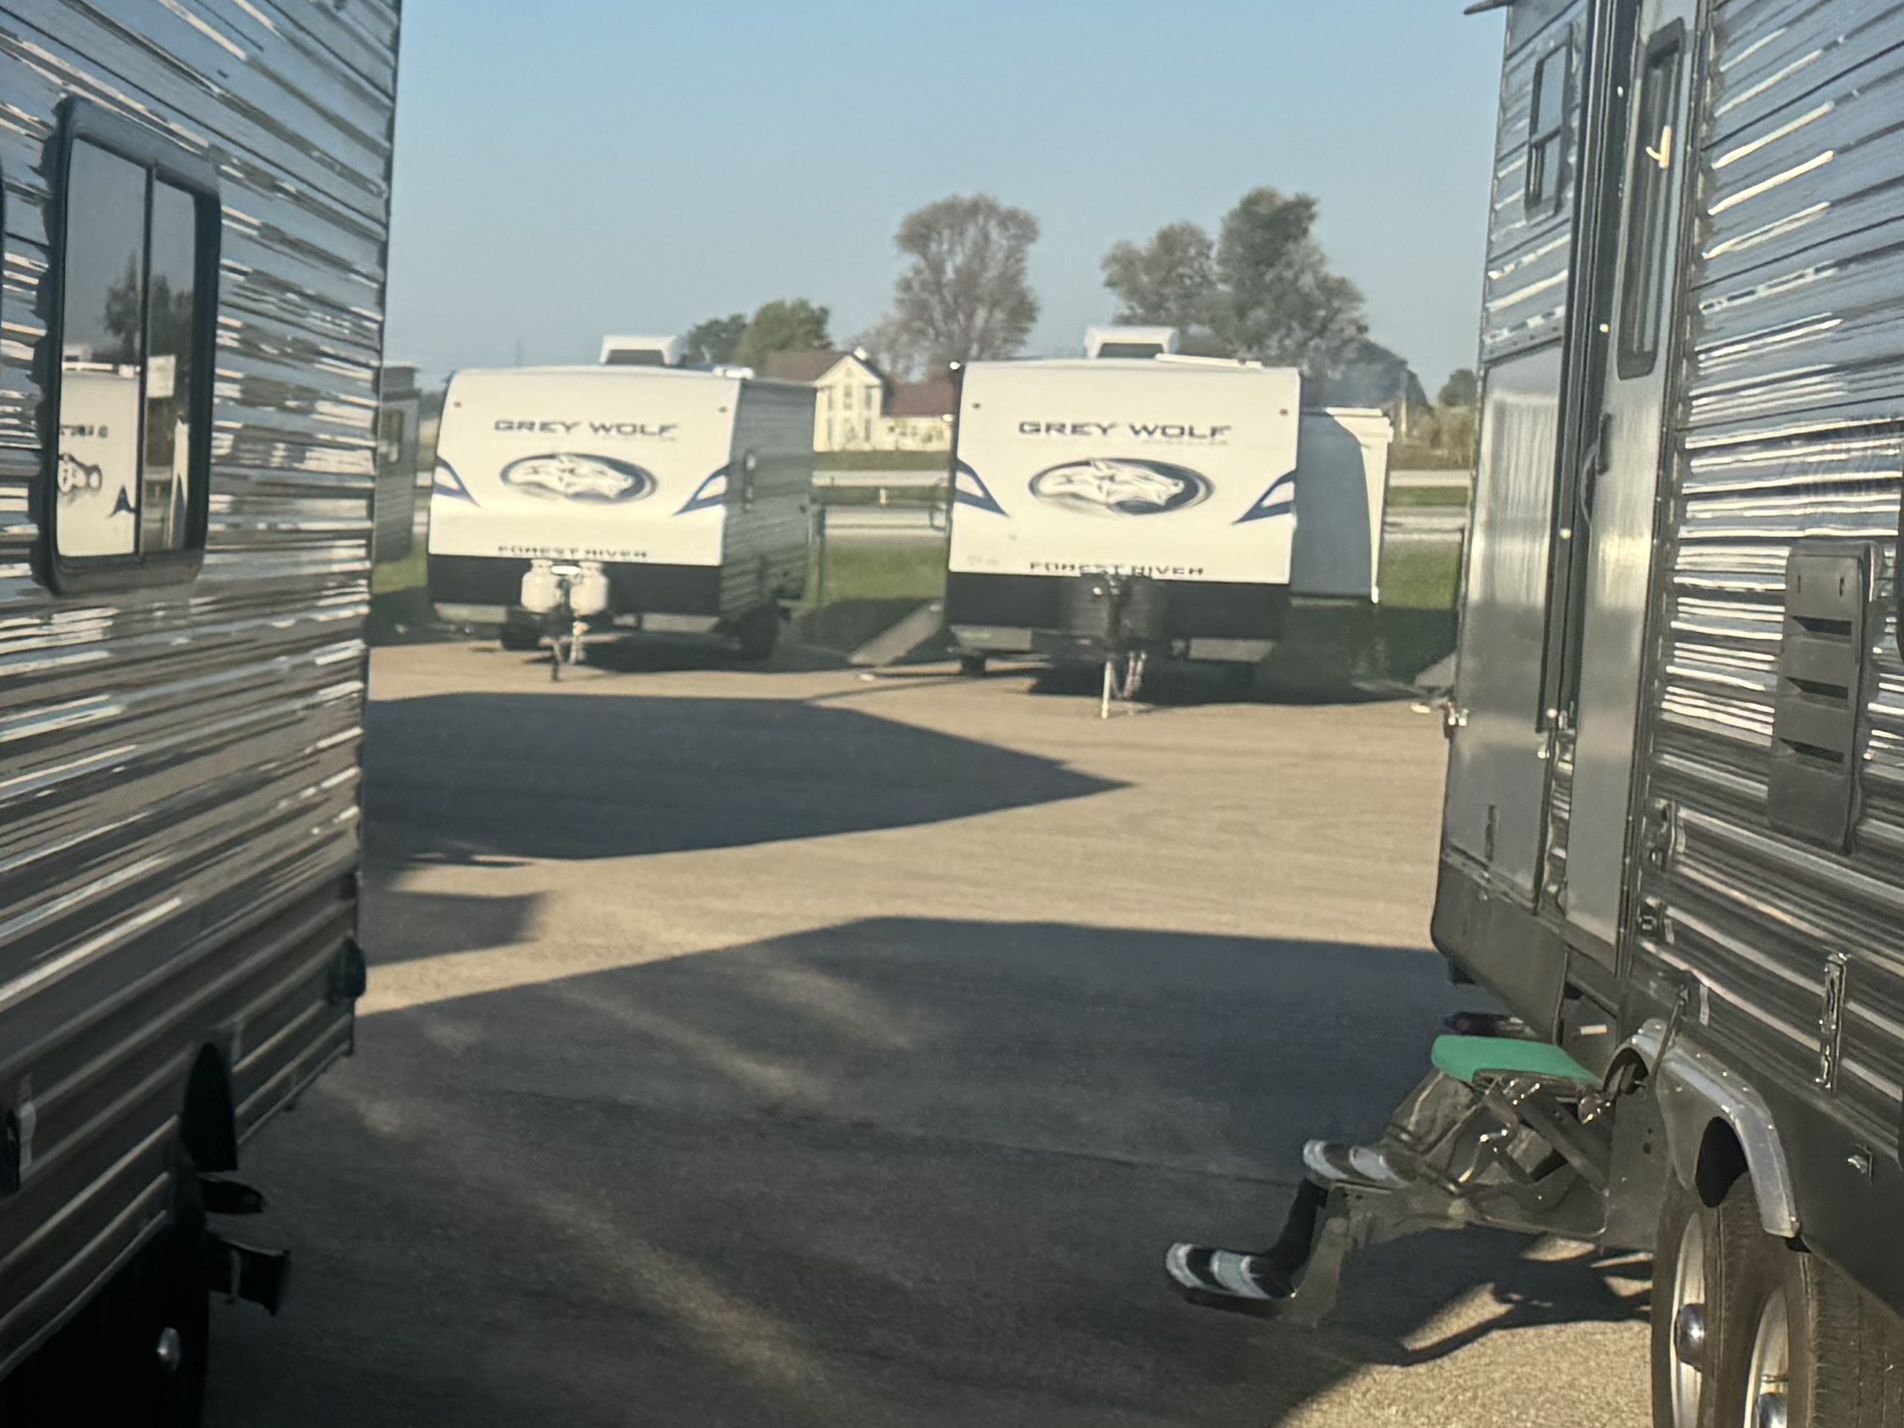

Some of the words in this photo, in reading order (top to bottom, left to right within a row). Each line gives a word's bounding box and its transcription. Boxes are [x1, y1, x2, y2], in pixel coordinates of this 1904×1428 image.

[494, 419, 581, 434] GREY
[589, 421, 678, 437] WOLF
[1018, 421, 1118, 437] GREY
[1128, 424, 1232, 440] WOLF
